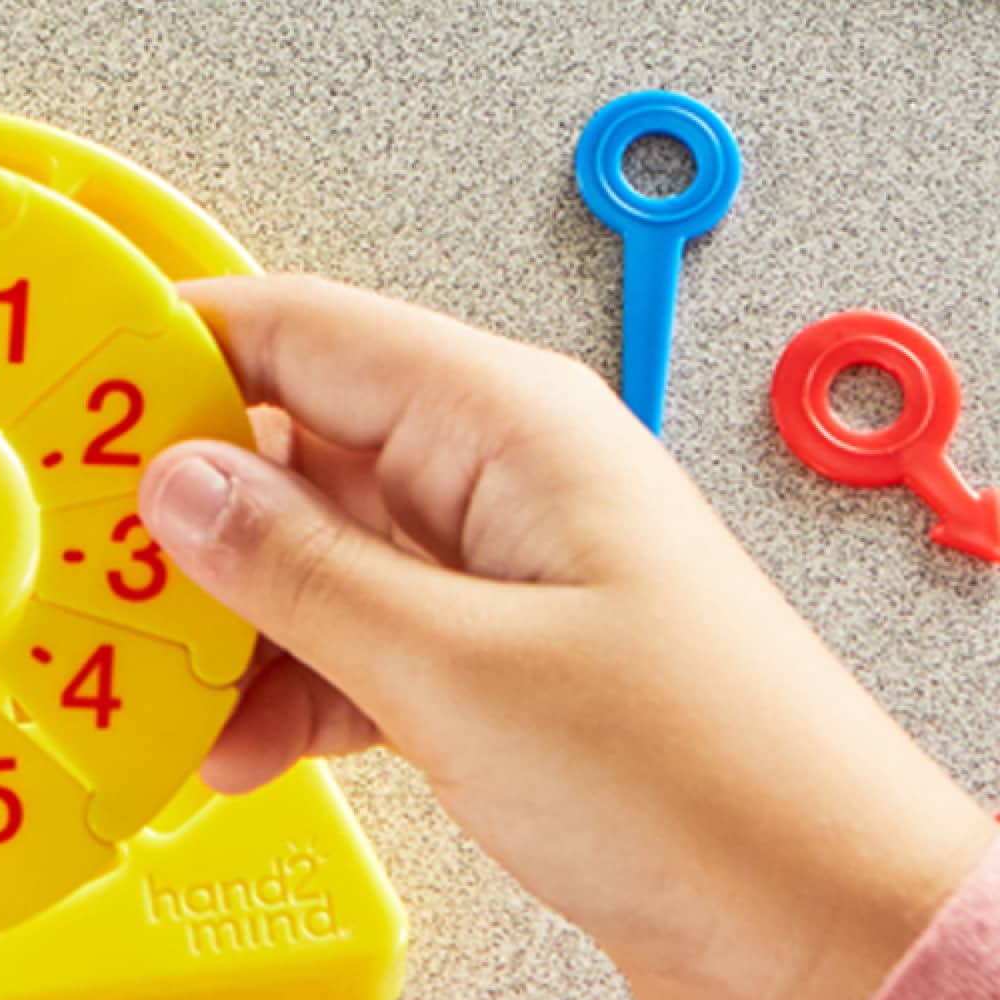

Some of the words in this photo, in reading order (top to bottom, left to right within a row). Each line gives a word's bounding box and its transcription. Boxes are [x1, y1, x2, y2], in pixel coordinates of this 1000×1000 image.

[82, 379, 145, 467] 2
[106, 513, 168, 602] 3
[60, 644, 122, 729] 4
[143, 851, 328, 925] hand2
